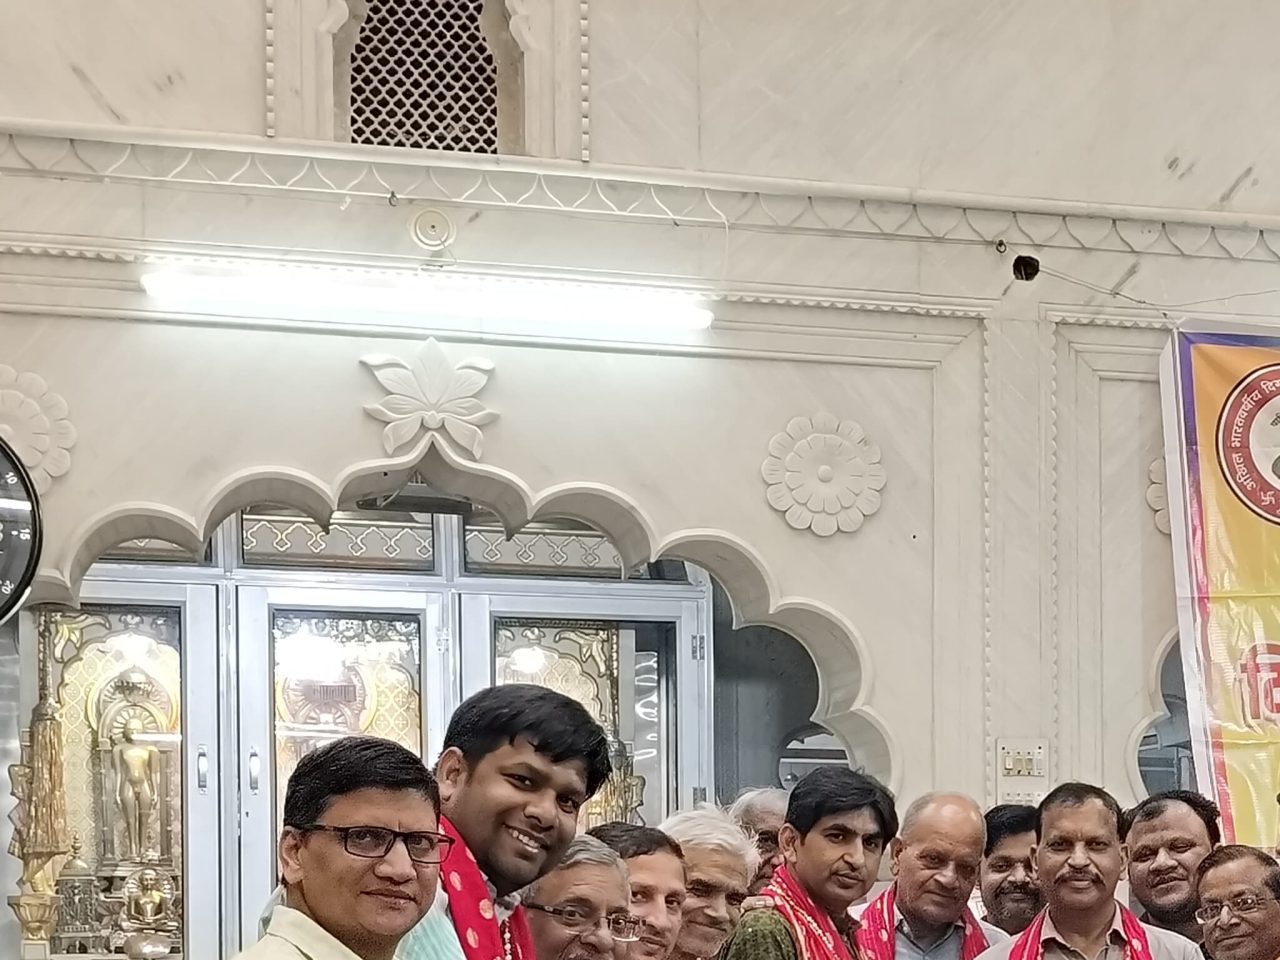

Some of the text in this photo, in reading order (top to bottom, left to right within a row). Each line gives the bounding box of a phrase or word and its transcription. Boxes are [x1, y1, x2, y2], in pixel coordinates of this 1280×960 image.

[4, 471, 18, 485] 10
[1231, 452, 1256, 491] अखिल
[20, 527, 31, 541] 15
[1, 579, 15, 595] 20
